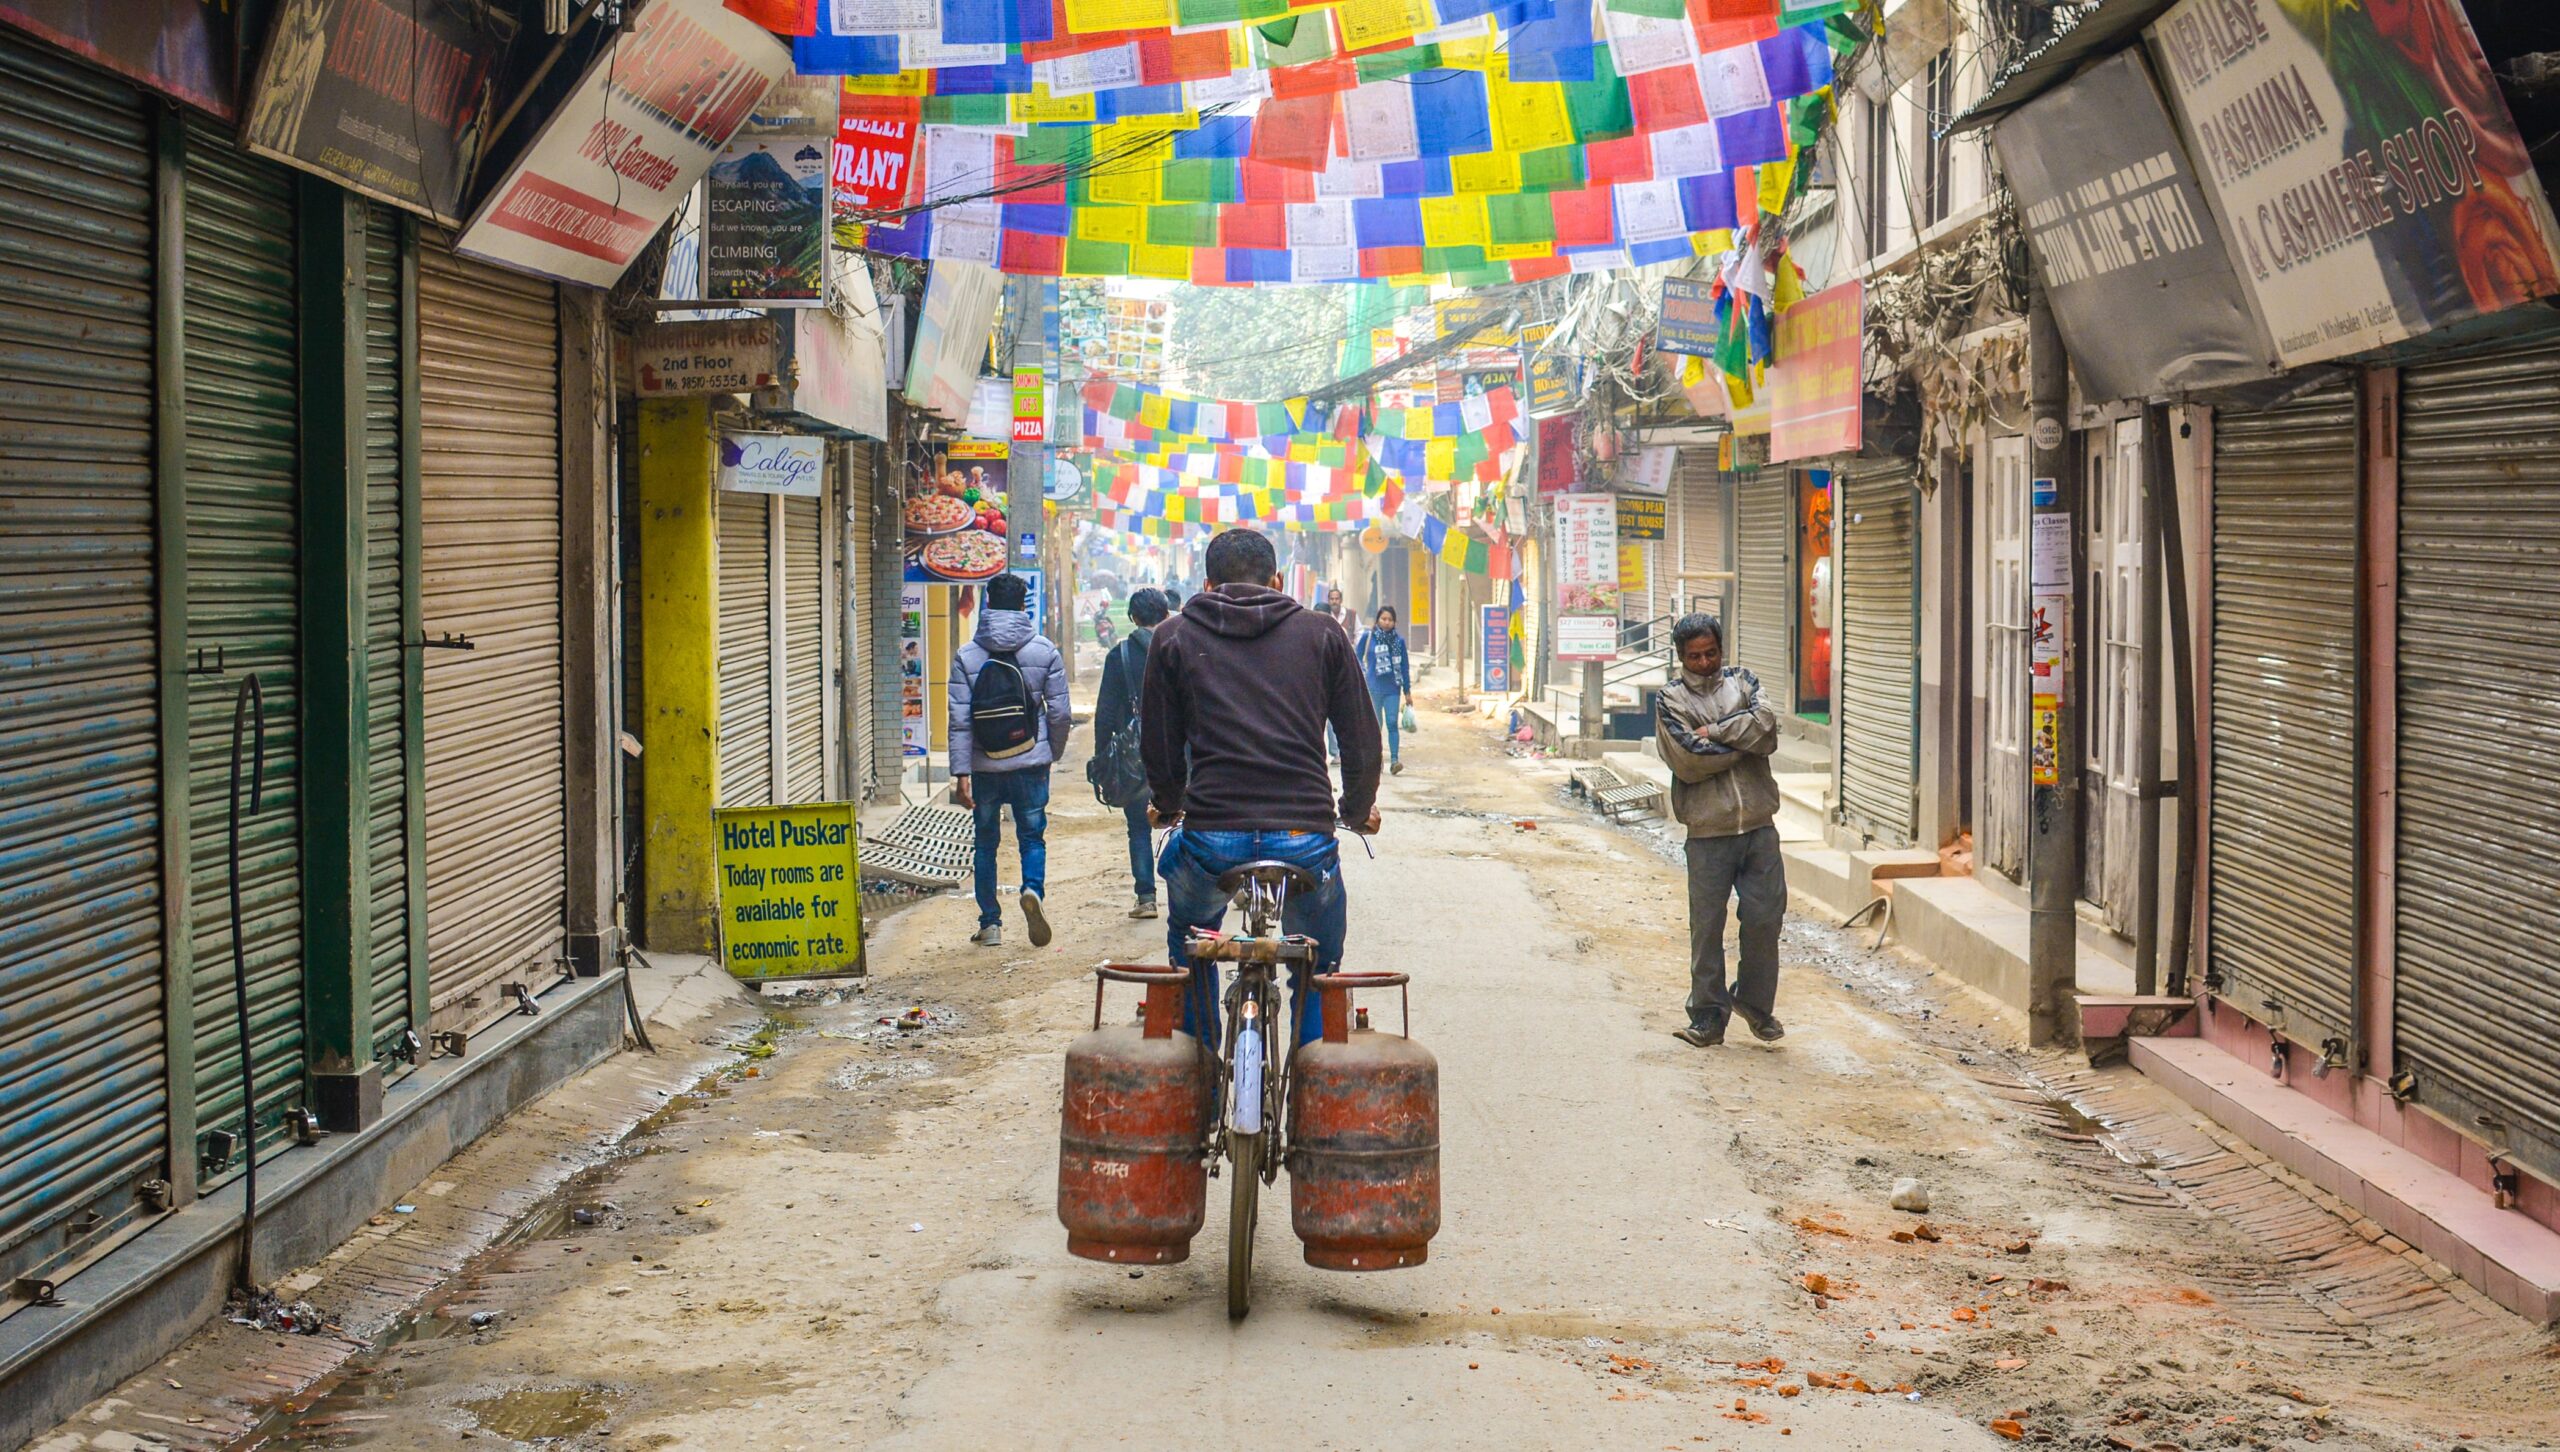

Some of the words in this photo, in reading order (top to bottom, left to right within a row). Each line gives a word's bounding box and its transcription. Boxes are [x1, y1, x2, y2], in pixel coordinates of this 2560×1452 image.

[2164, 0, 2269, 93] NEPALESE
[692, 59, 771, 147] LAND
[2200, 64, 2327, 187] PASHMINA
[580, 117, 632, 168] 100%
[614, 134, 680, 192] Guarantee
[711, 180, 730, 190] They
[732, 180, 750, 190] said,
[752, 182, 768, 191] you
[2238, 215, 2269, 281] &
[2257, 149, 2394, 271] CASHMERE
[2382, 107, 2482, 215] SHOP
[711, 200, 778, 212] ESCAPING.
[502, 186, 589, 236] MANUFACTURE
[576, 211, 607, 243] AND
[711, 224, 724, 232] But
[740, 224, 770, 233] known,
[771, 226, 787, 234] you
[710, 246, 777, 259] CLIMBING!
[710, 268, 744, 276] Towards
[1665, 282, 1694, 298] WEL
[662, 357, 689, 371] 2nd
[694, 355, 734, 370] Floor
[1019, 397, 1039, 412] JOE'S
[1013, 420, 1042, 437] PIZZA
[2035, 424, 2061, 435] Hotel
[740, 441, 817, 486] Caligo
[1646, 501, 1664, 513] PEAK
[1593, 518, 1610, 527] China
[1638, 515, 1664, 528] HOUSE
[1594, 541, 1610, 549] Zhou
[1597, 563, 1609, 571] Hot
[1598, 574, 1609, 582] Pot
[901, 596, 921, 608] Spa
[723, 820, 775, 851] Hotel
[780, 818, 850, 848] Puskar
[724, 864, 766, 892] Today
[771, 865, 815, 885] rooms
[819, 863, 844, 882] are
[735, 897, 805, 923] available
[811, 895, 839, 918] for
[732, 934, 800, 961] economic
[806, 933, 849, 957] rate.
